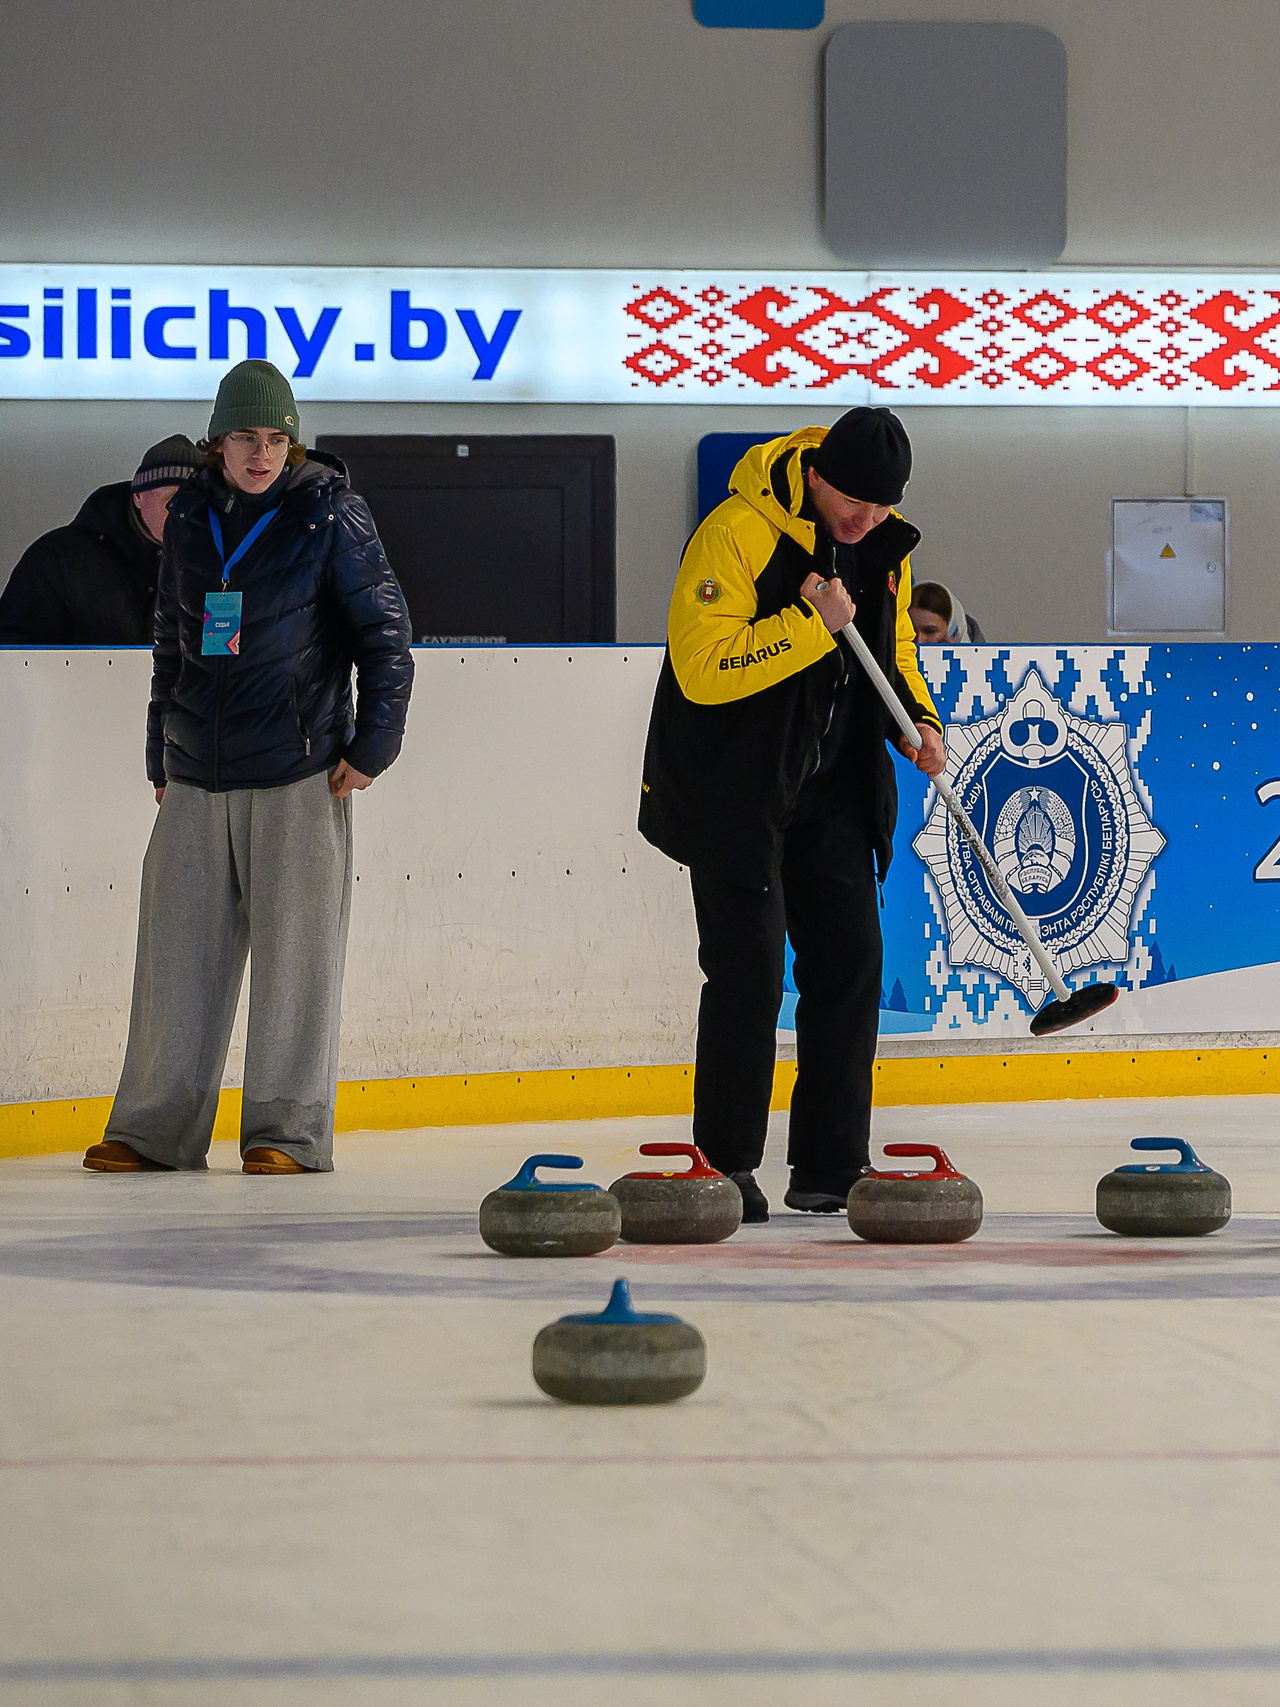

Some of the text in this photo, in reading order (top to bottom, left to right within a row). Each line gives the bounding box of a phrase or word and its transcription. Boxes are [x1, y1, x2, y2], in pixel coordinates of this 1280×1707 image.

[1090, 779, 1112, 850] БЕЛАРУСЬ
[968, 870, 1005, 927] СПРАВАМІ
[1070, 853, 1111, 923] РЭСПУБЛІКІ
